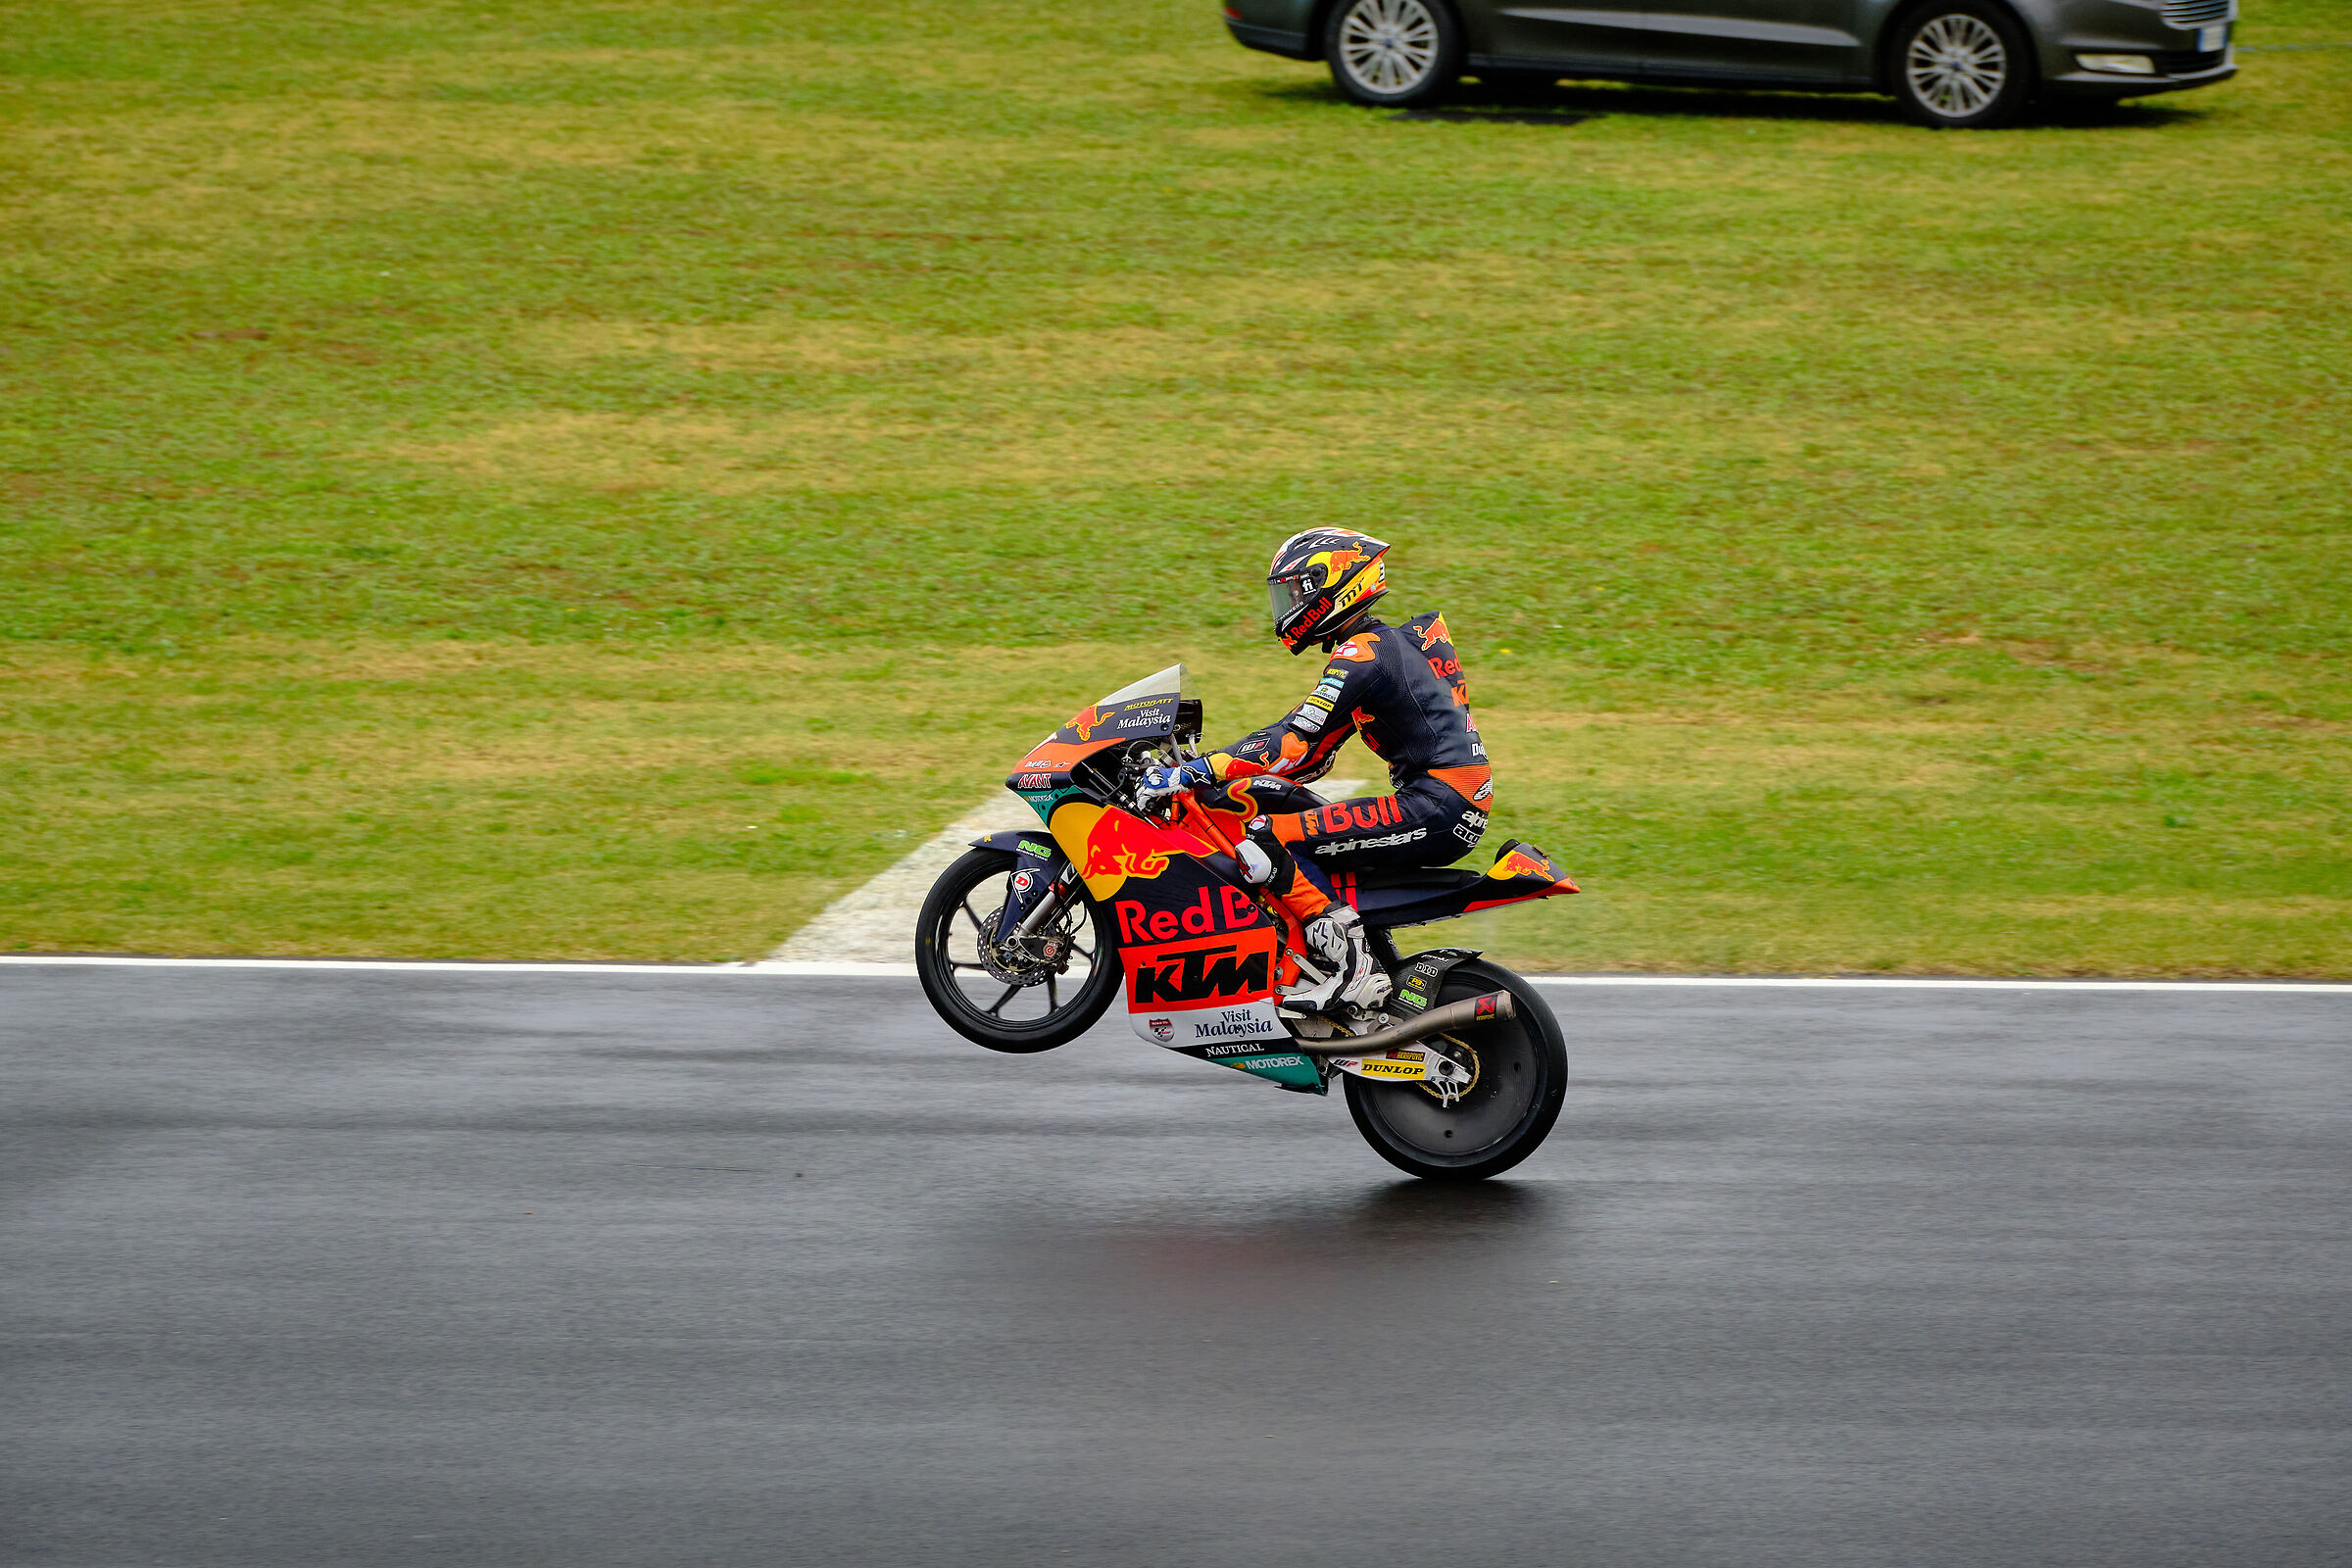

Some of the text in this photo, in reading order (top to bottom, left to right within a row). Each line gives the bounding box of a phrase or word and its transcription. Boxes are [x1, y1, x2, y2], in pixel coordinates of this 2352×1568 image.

[1140, 708, 1160, 717] Visit
[1116, 713, 1171, 730] Malaysia
[1017, 773, 1052, 788] AVANT
[1252, 779, 1282, 791] KTM
[1322, 794, 1403, 833] Bull
[1017, 839, 1052, 858] NG
[1315, 827, 1428, 856] alpinestars
[1114, 886, 1215, 944] Red
[1135, 944, 1269, 1004] KTM
[1399, 989, 1428, 1006] NG
[1221, 1008, 1252, 1023] Visit
[1195, 1018, 1273, 1038] Malaysia
[1205, 1044, 1265, 1057] NAUTICAL
[1245, 1056, 1305, 1070] MOTOREX
[1361, 1063, 1425, 1075] DUNLOP
